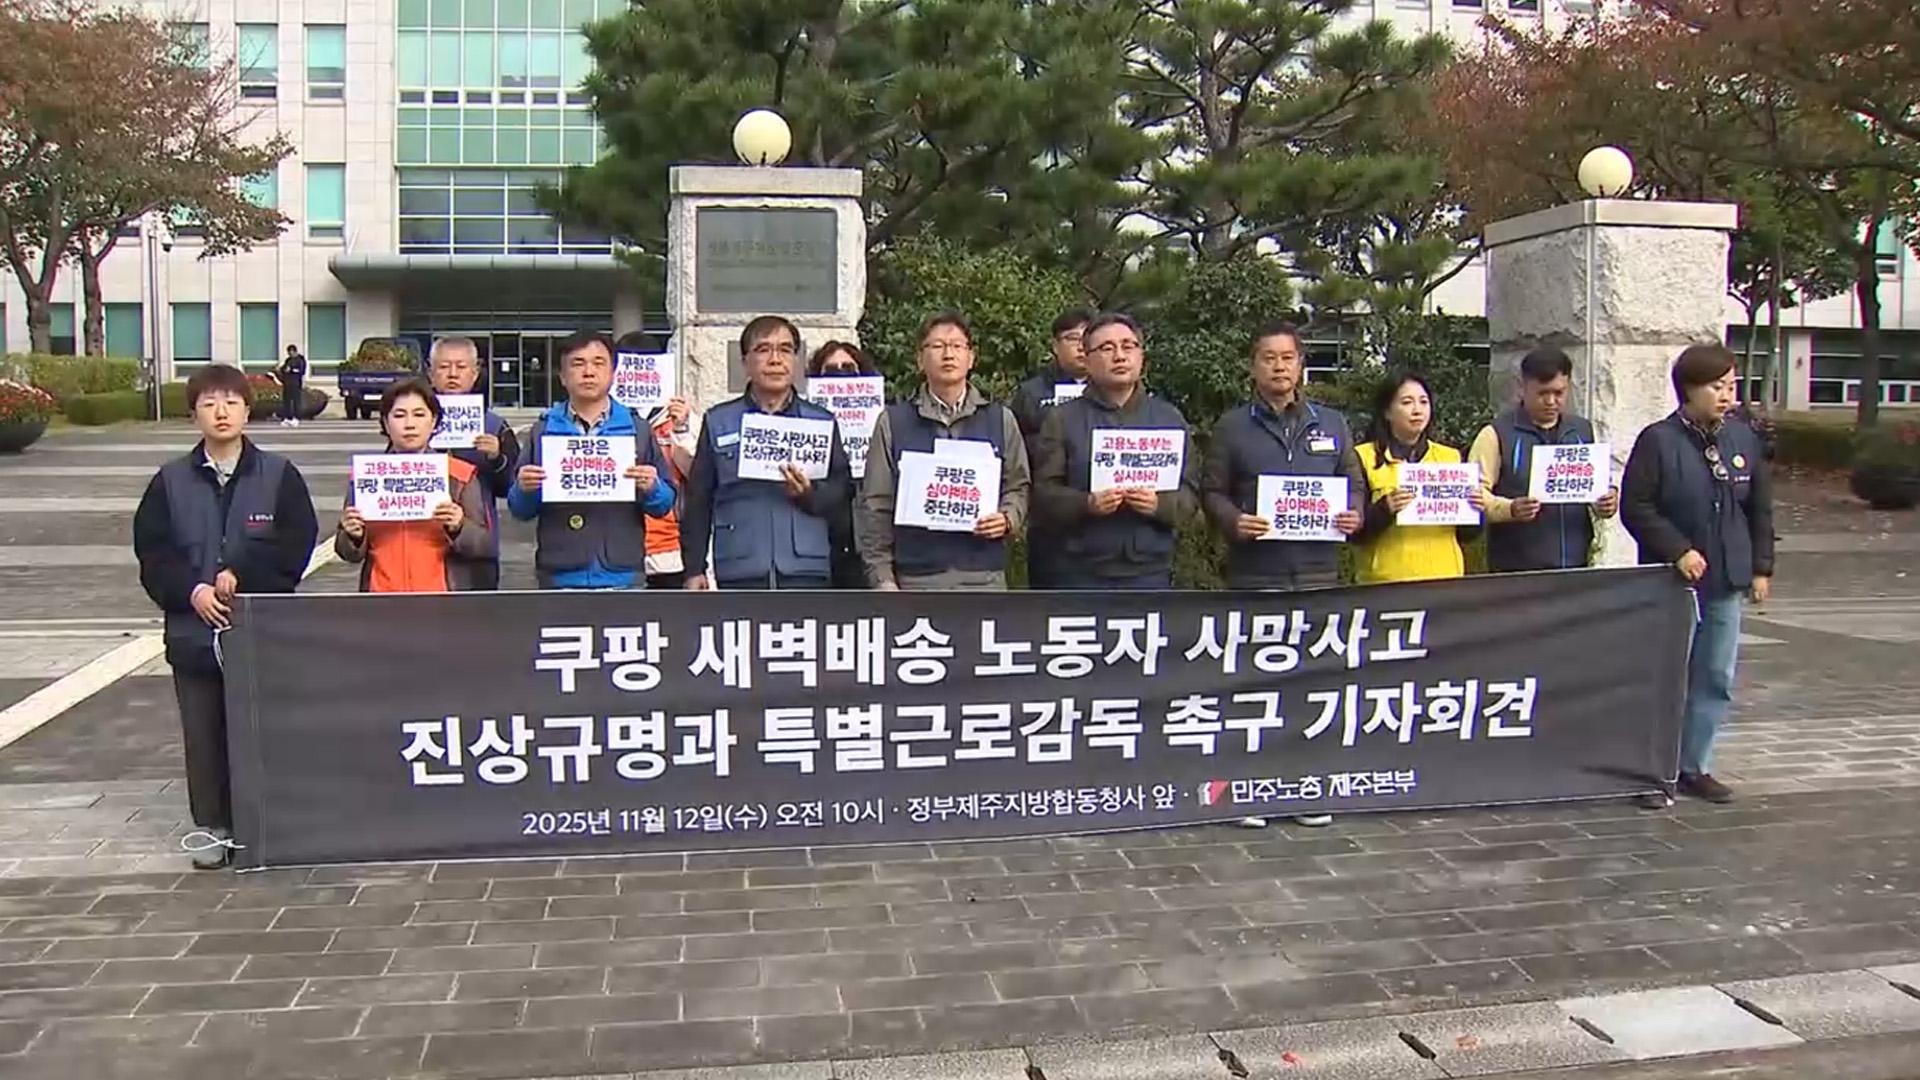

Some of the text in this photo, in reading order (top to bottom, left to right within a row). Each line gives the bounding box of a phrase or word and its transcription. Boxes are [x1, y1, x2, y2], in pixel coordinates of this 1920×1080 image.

[622, 355, 656, 371] 쿠팡은
[616, 370, 661, 385] 심야배송
[616, 384, 662, 399] 중단하라
[817, 382, 876, 395] 고용노동부는
[743, 426, 829, 449] 쿠팡은 사망사고
[1101, 436, 1173, 451] 고용노동부는
[566, 439, 610, 456] 쿠팡은
[1553, 446, 1591, 463] 쿠팡은
[364, 461, 437, 476] 고용노동부는
[560, 456, 617, 473] 심야배송
[1094, 452, 1116, 468] 쿠팡
[934, 466, 977, 485] 쿠팡은
[1113, 469, 1159, 483] 실시하라
[1405, 468, 1470, 484] 고용노동부는
[1546, 463, 1595, 478] 심야배송
[356, 477, 379, 494] 쿠팡
[560, 473, 617, 490] 중단하라
[1282, 480, 1324, 497] 쿠팡은
[1544, 478, 1594, 494] 중단하라
[926, 482, 981, 502] 심야배송
[377, 495, 426, 510] 실시하라
[923, 498, 981, 519] 중단하라
[1274, 497, 1329, 514] 심야배송
[1415, 501, 1460, 515] 실시하라
[1274, 513, 1329, 530] 중단하라
[534, 609, 1429, 692] 쿠팡 새벽배송 노동자 사망사고
[402, 677, 1538, 785] 진상규명과 특별근로감독 촉구 기자회견
[522, 769, 1417, 836] 2025년 11월 12일(수) 오전 10시 정부제주지방합동청사 앞 민주노총 제주본부
